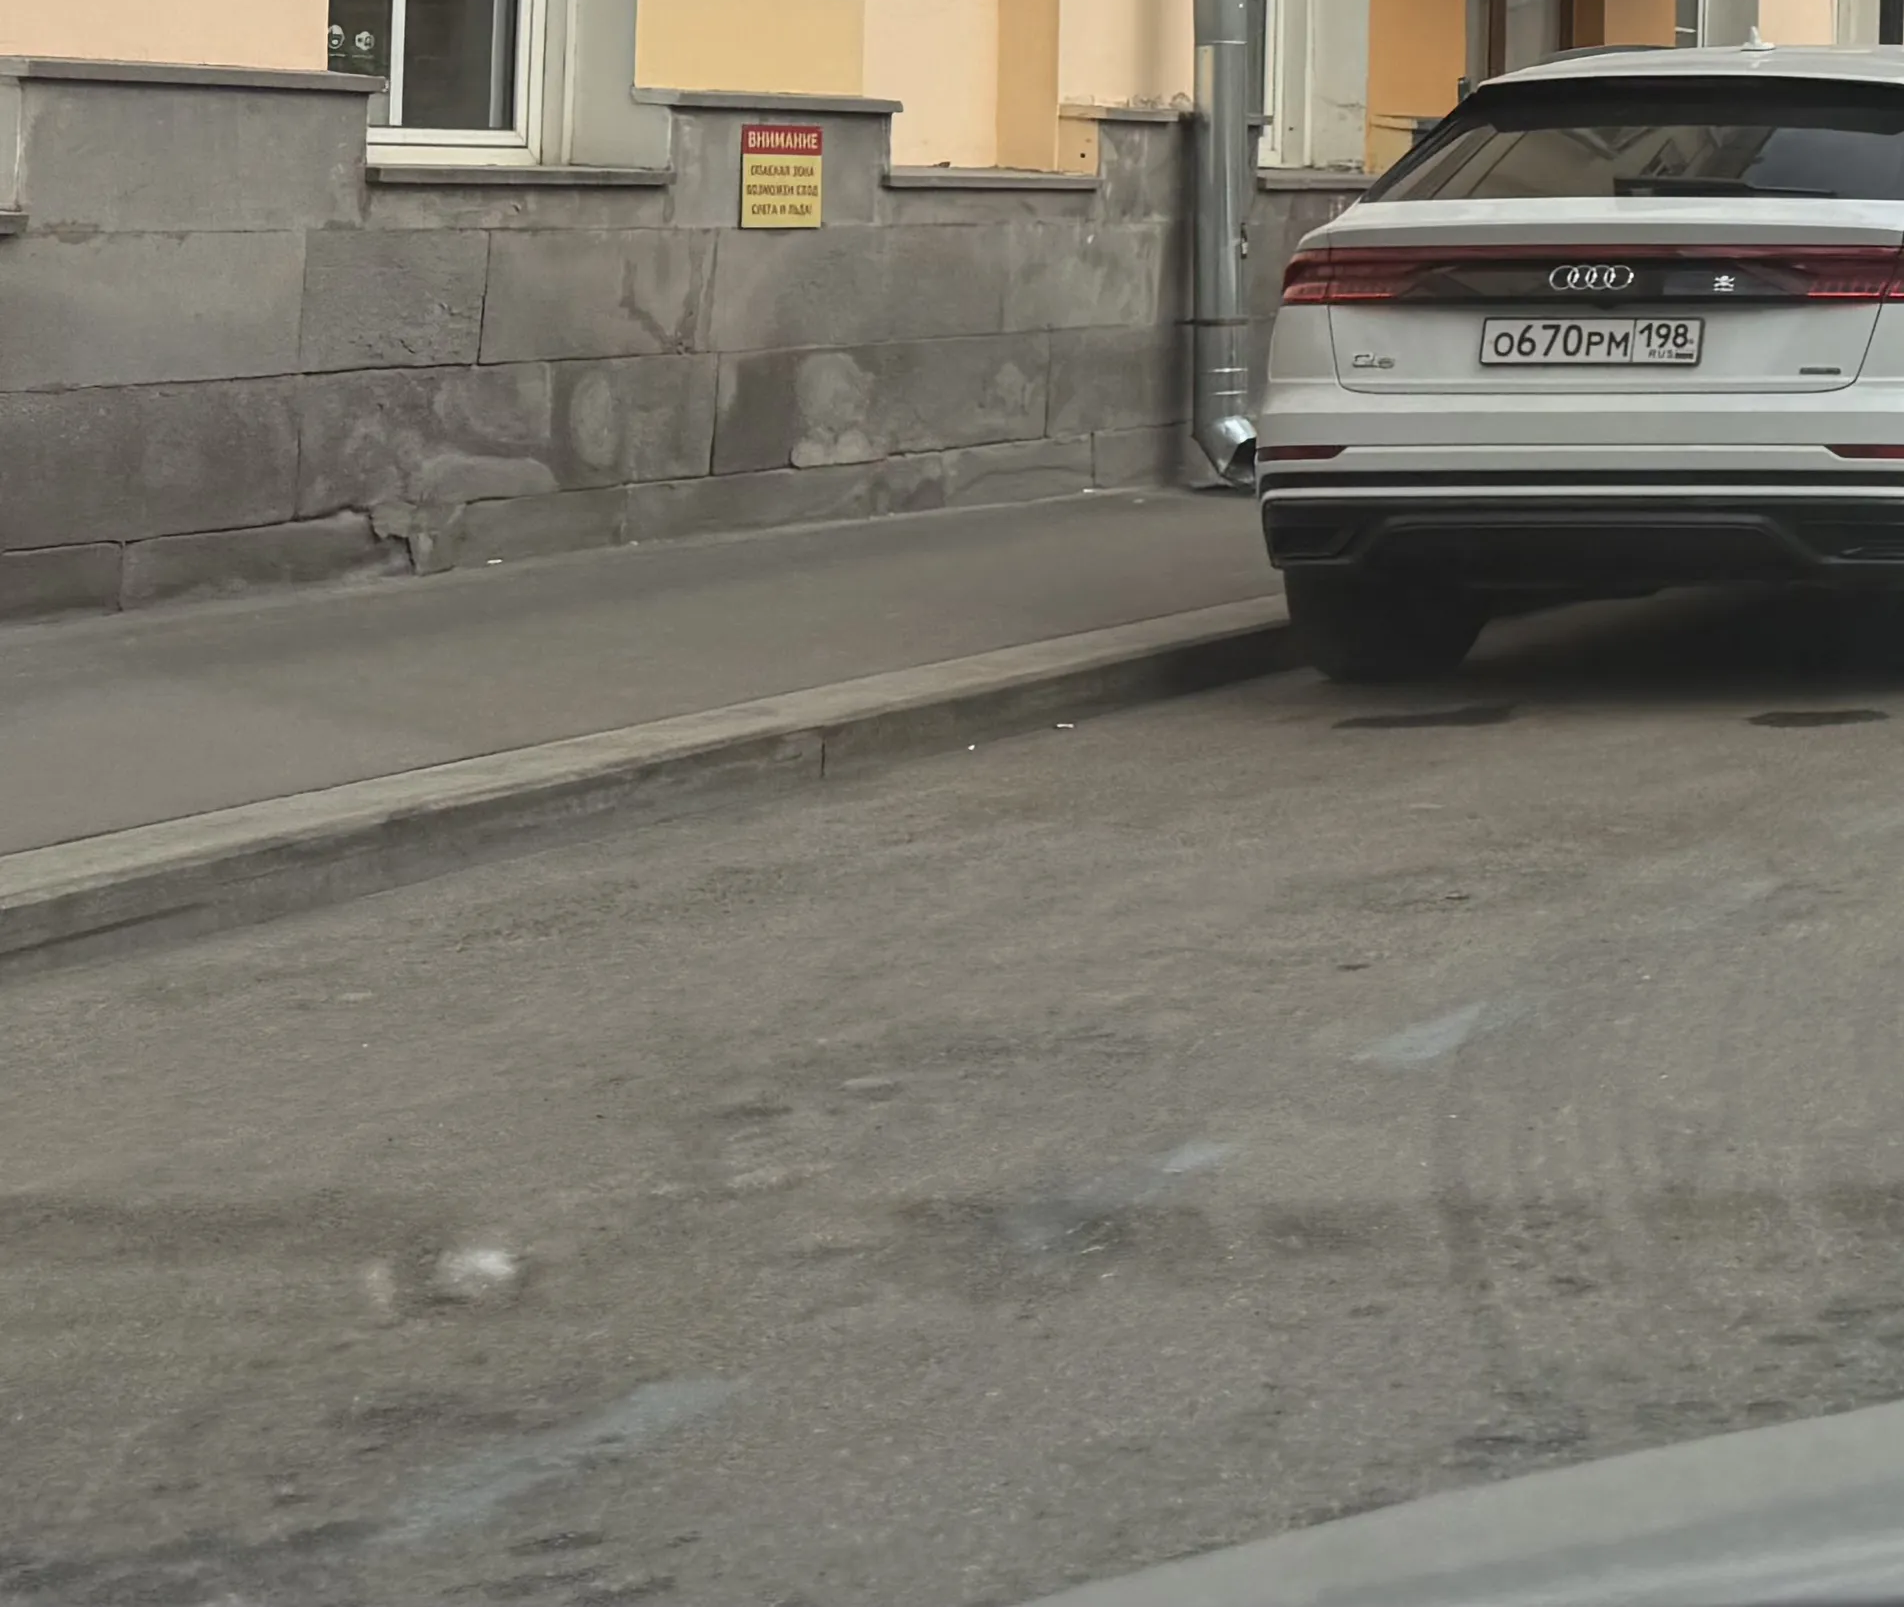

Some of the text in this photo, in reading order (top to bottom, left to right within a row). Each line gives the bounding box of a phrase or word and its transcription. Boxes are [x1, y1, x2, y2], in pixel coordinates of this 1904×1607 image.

[748, 130, 818, 149] ВНИМАНИЕ
[1638, 322, 1690, 349] 198
[1648, 350, 1675, 359] RUS
